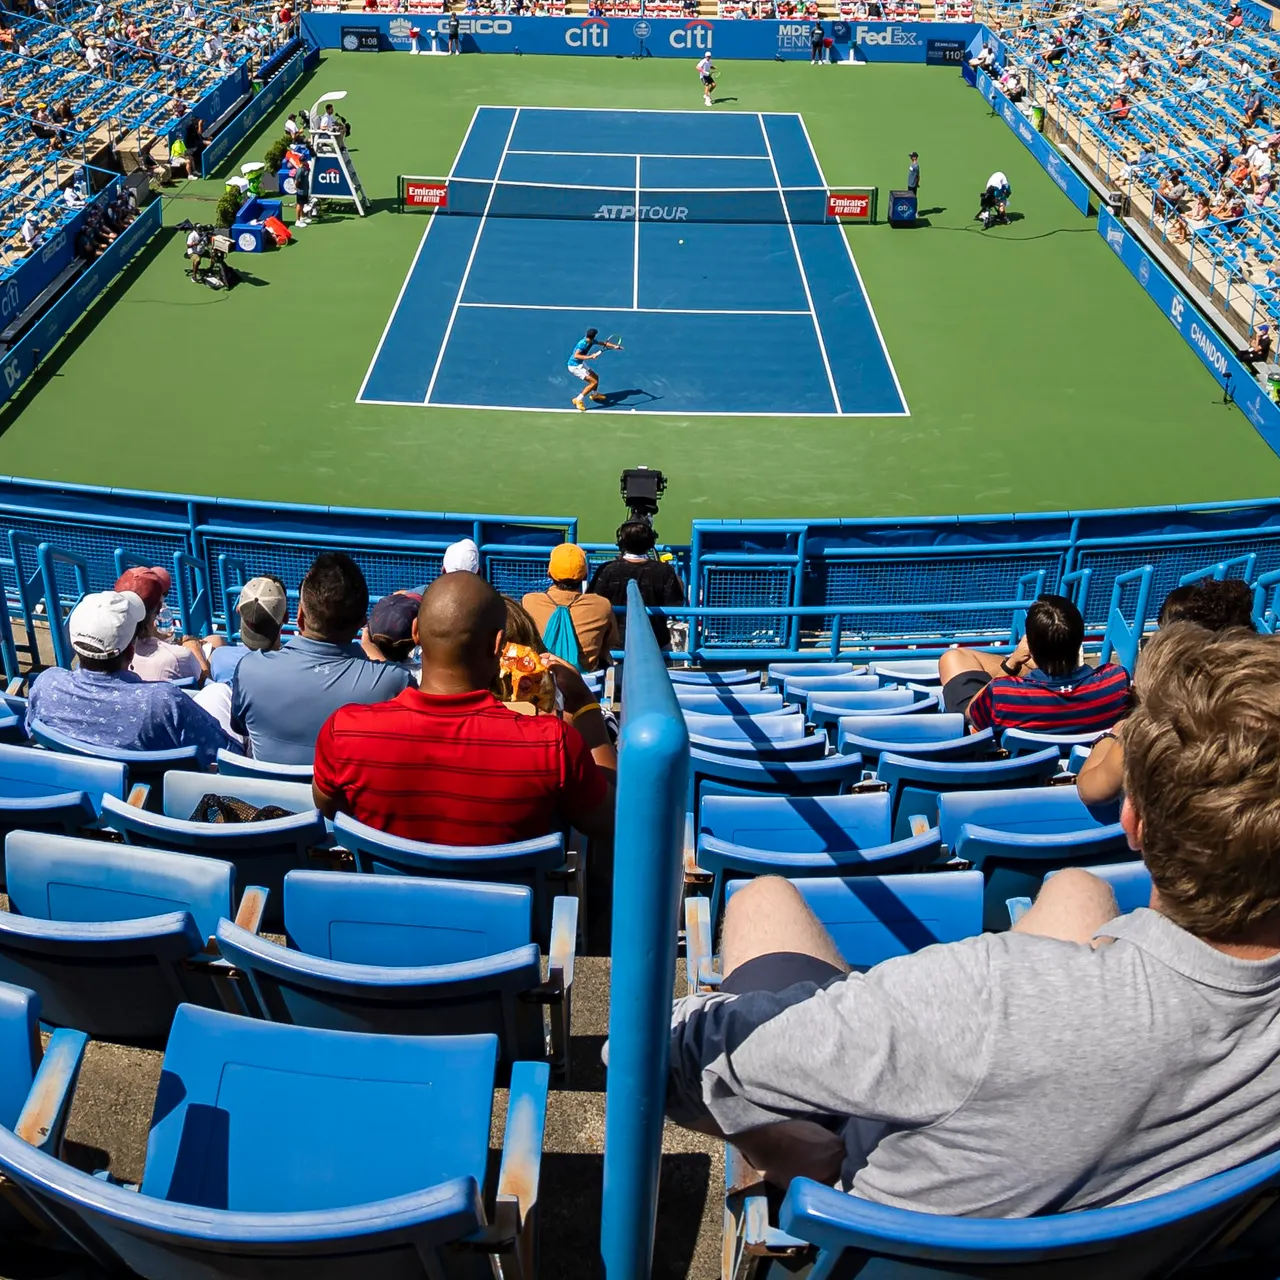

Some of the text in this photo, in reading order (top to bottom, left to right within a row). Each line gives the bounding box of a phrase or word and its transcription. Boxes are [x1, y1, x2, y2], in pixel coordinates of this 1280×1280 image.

[565, 22, 608, 47] citi
[669, 23, 712, 49] citi
[856, 26, 917, 45] FedEx
[945, 50, 960, 60] 110
[318, 171, 340, 184] citi
[409, 187, 446, 195] Emirates
[830, 198, 867, 207] Emirates
[592, 205, 689, 220] ATP TOUR
[42, 232, 67, 263] GEICO
[1, 281, 19, 316] citi
[1172, 298, 1185, 323] DC
[1190, 323, 1228, 374] CHANDON
[4, 358, 21, 388] DC
